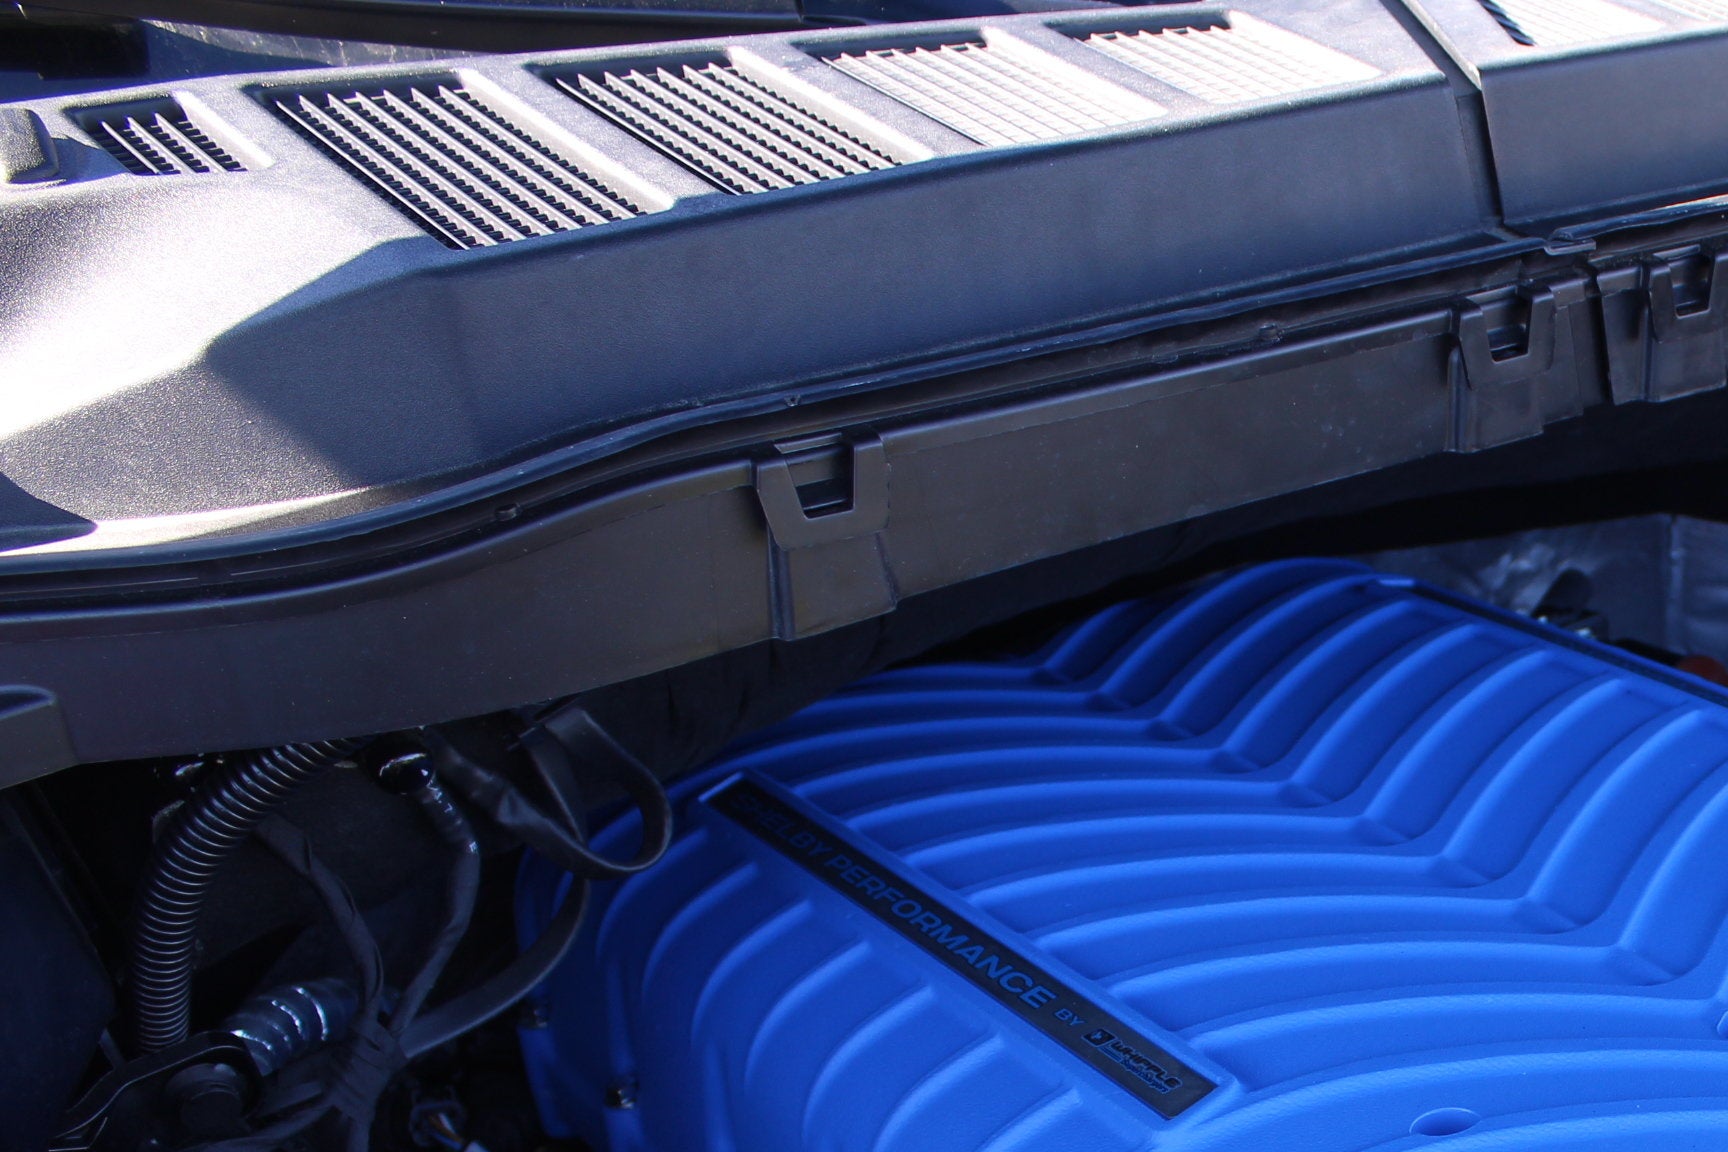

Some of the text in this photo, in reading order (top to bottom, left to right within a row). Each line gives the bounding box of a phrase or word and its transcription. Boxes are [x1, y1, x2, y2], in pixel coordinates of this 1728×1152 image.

[729, 795, 1087, 1027] SHELBY PERFORMANCE BY
[1108, 1040, 1182, 1089] WHIPPLE
